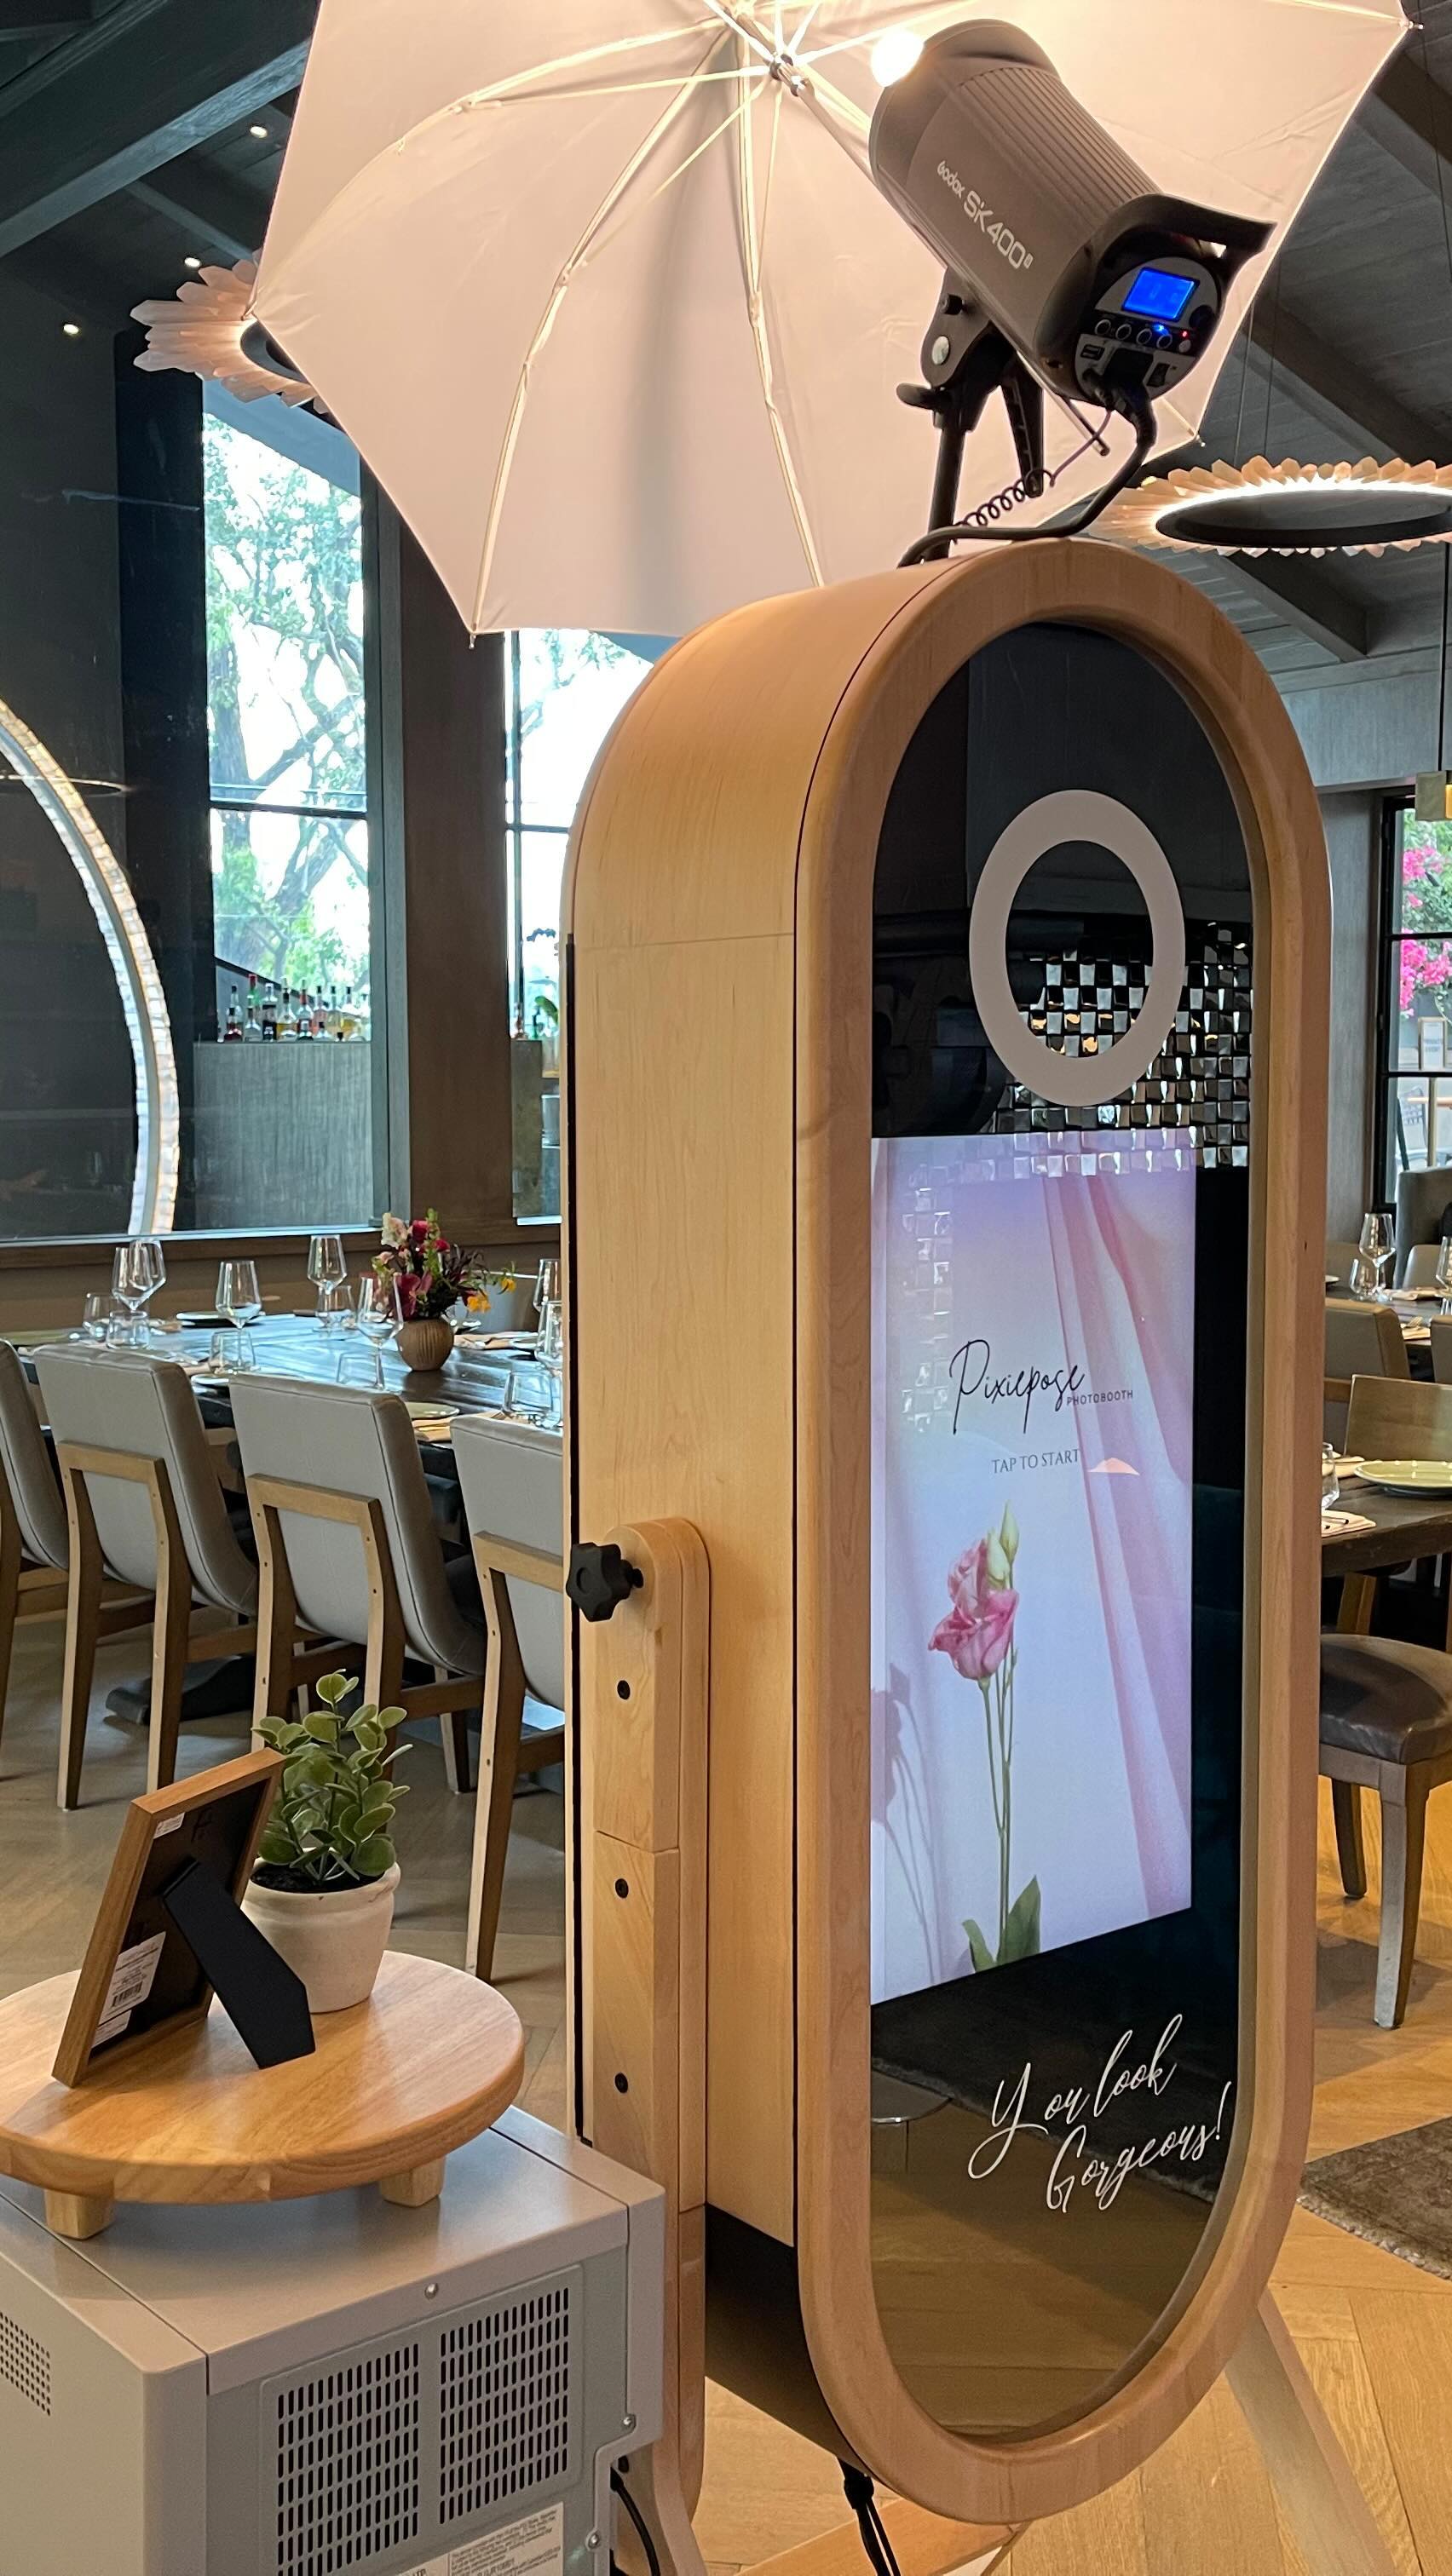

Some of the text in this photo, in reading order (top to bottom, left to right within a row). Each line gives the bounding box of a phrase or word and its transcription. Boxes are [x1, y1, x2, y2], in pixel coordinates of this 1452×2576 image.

[949, 1339, 1085, 1435] Pixiepose
[1067, 1389, 1133, 1406] PHOTOBOOTH
[991, 1448, 1080, 1474] TAP TO START
[967, 2014, 1183, 2179] You look
[1046, 2081, 1232, 2213] Gorgeous!
